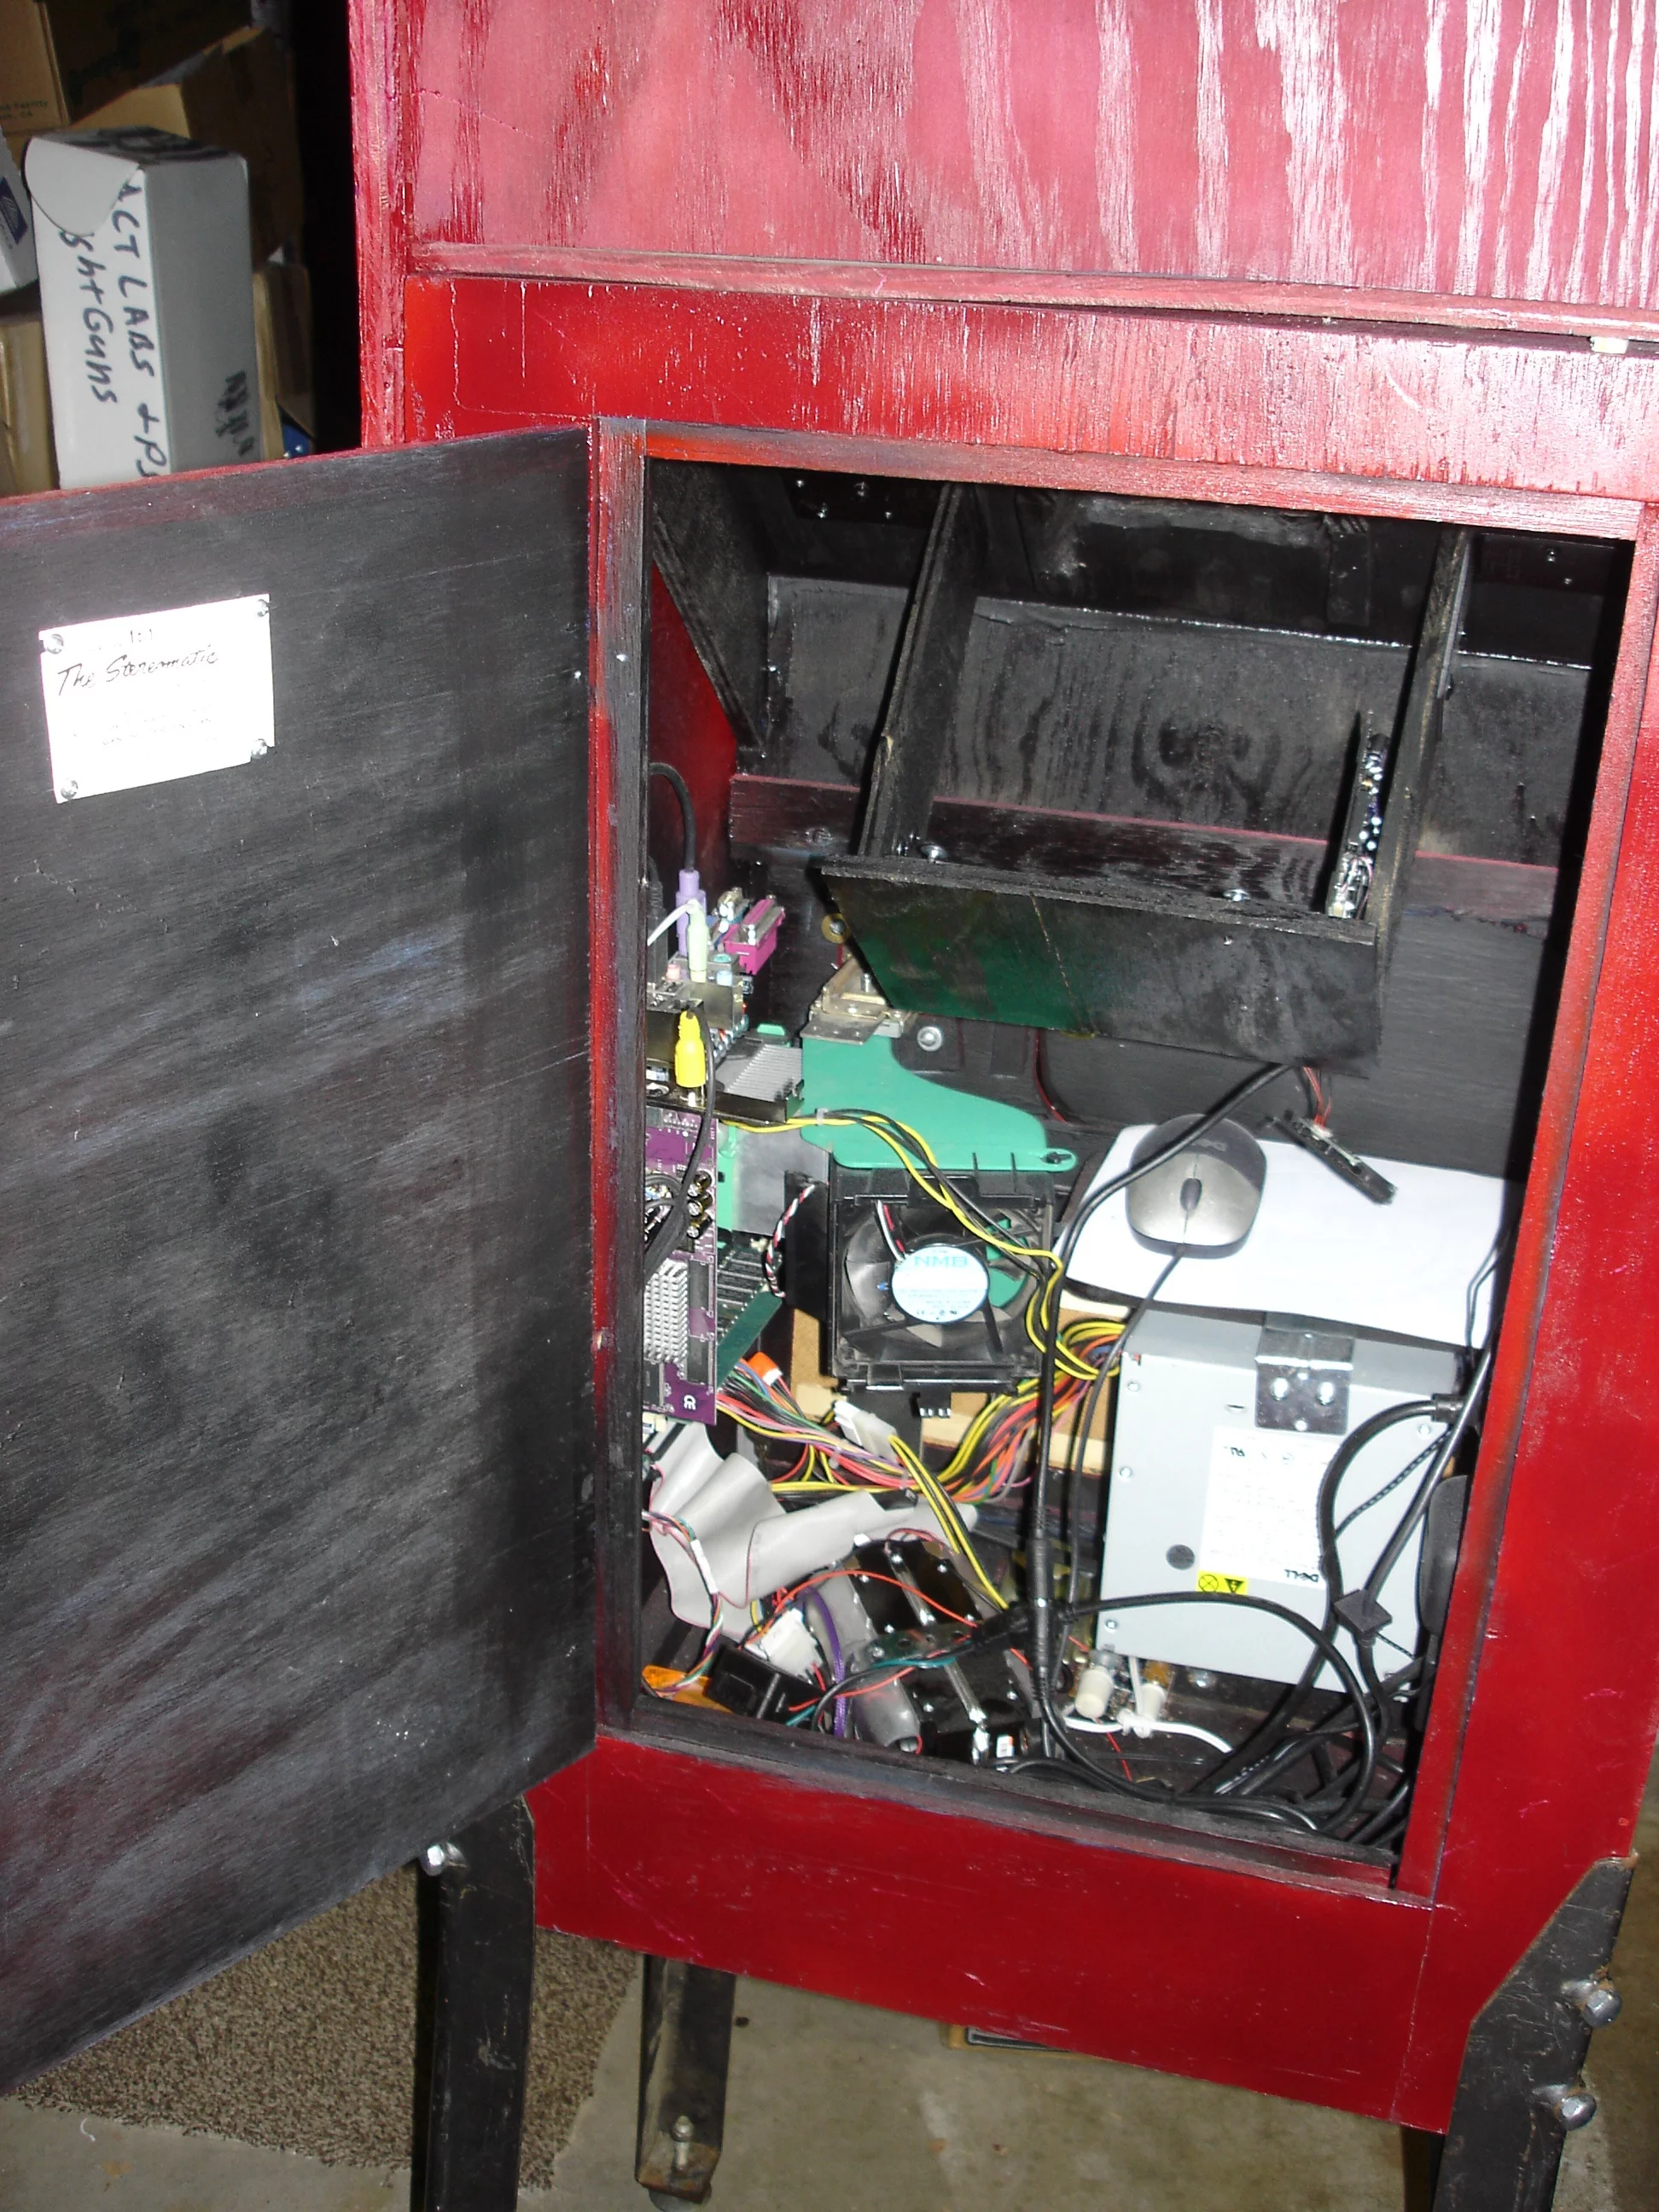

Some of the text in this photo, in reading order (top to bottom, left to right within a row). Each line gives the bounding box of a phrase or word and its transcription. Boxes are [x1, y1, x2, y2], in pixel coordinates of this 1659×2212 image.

[118, 275, 154, 377] LABS
[57, 662, 96, 696] The
[914, 1256, 968, 1267] NMB
